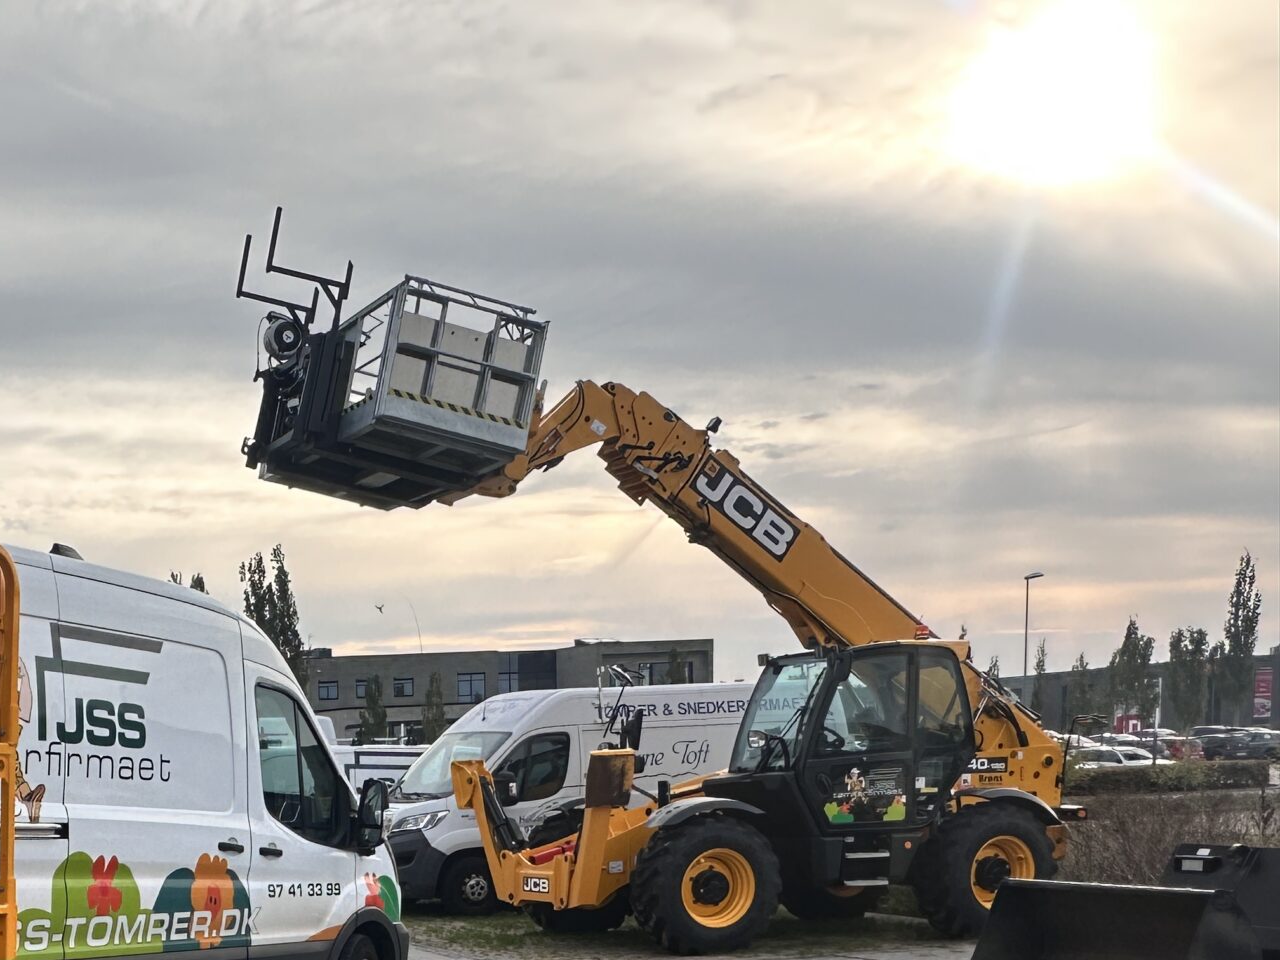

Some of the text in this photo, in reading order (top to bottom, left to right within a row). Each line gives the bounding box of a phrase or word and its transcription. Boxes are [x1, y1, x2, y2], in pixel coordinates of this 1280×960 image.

[696, 472, 795, 556] JCB
[56, 698, 147, 749] JSS
[662, 703, 674, 716] &
[25, 741, 171, 782] rfirmaet
[672, 740, 710, 769] Toft
[268, 883, 341, 898] 97 41 33 99
[523, 877, 549, 892] JCB
[17, 906, 262, 951] S-TOMRER.DK
